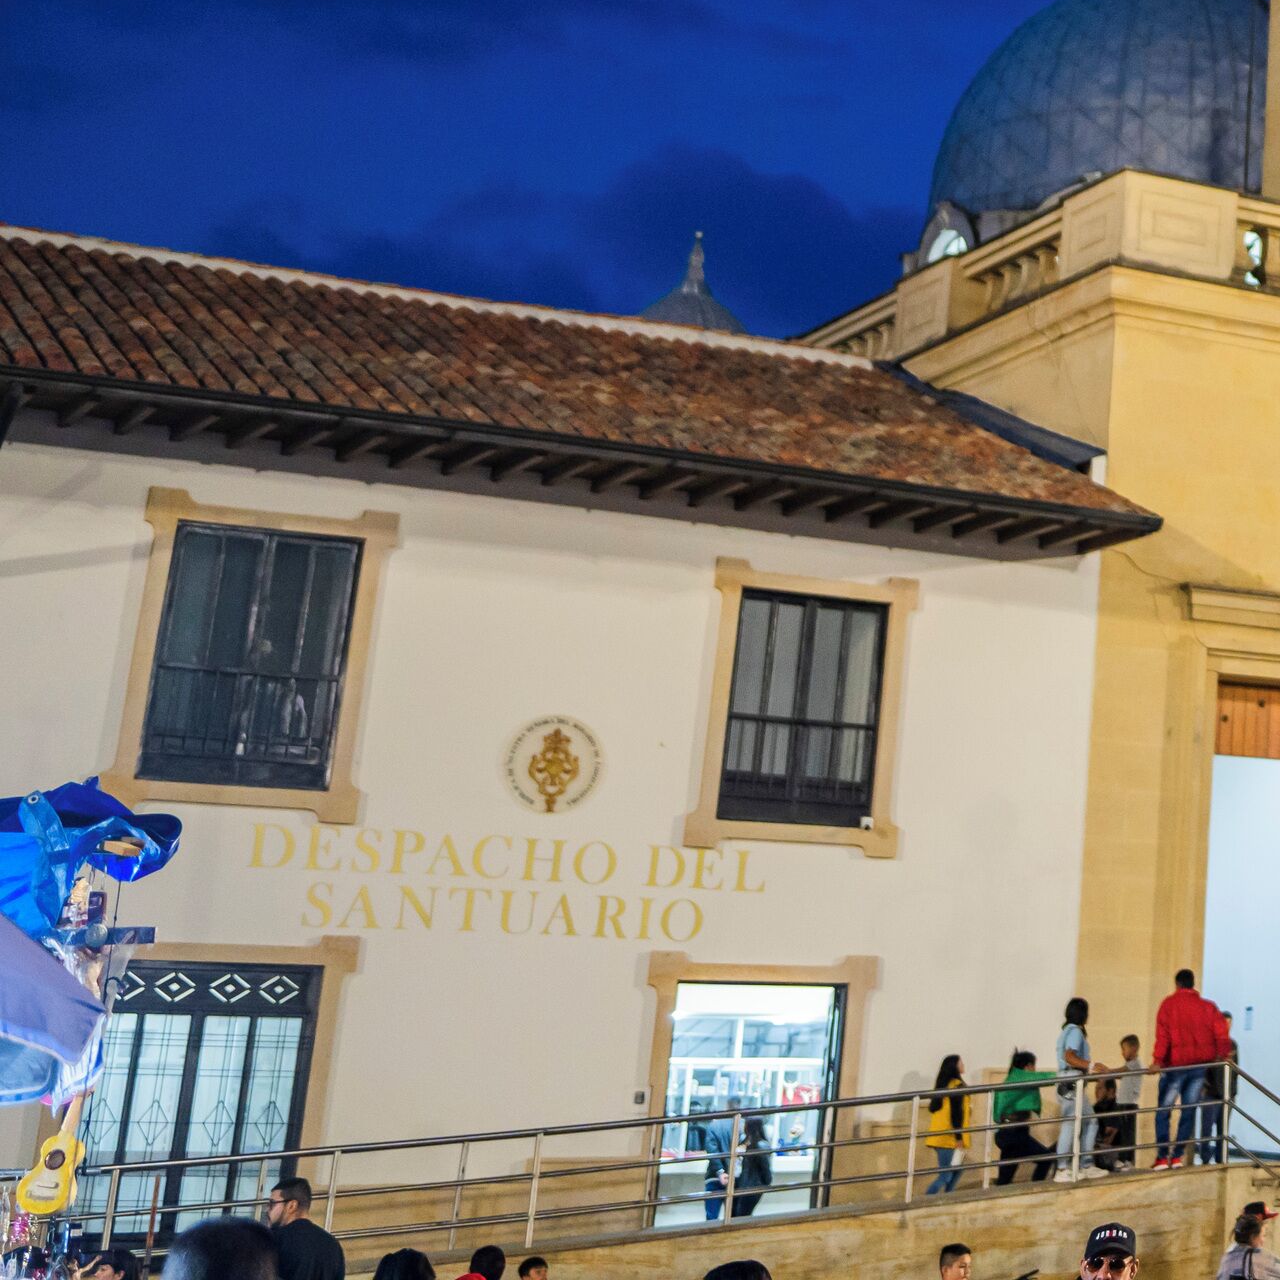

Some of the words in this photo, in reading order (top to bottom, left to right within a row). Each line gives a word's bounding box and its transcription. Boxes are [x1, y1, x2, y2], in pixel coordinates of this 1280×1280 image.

[246, 822, 618, 885] DESPACHO
[644, 843, 766, 894] DEL
[301, 881, 705, 943] SANTUARIO
[1095, 1229, 1128, 1240] JORDAN
